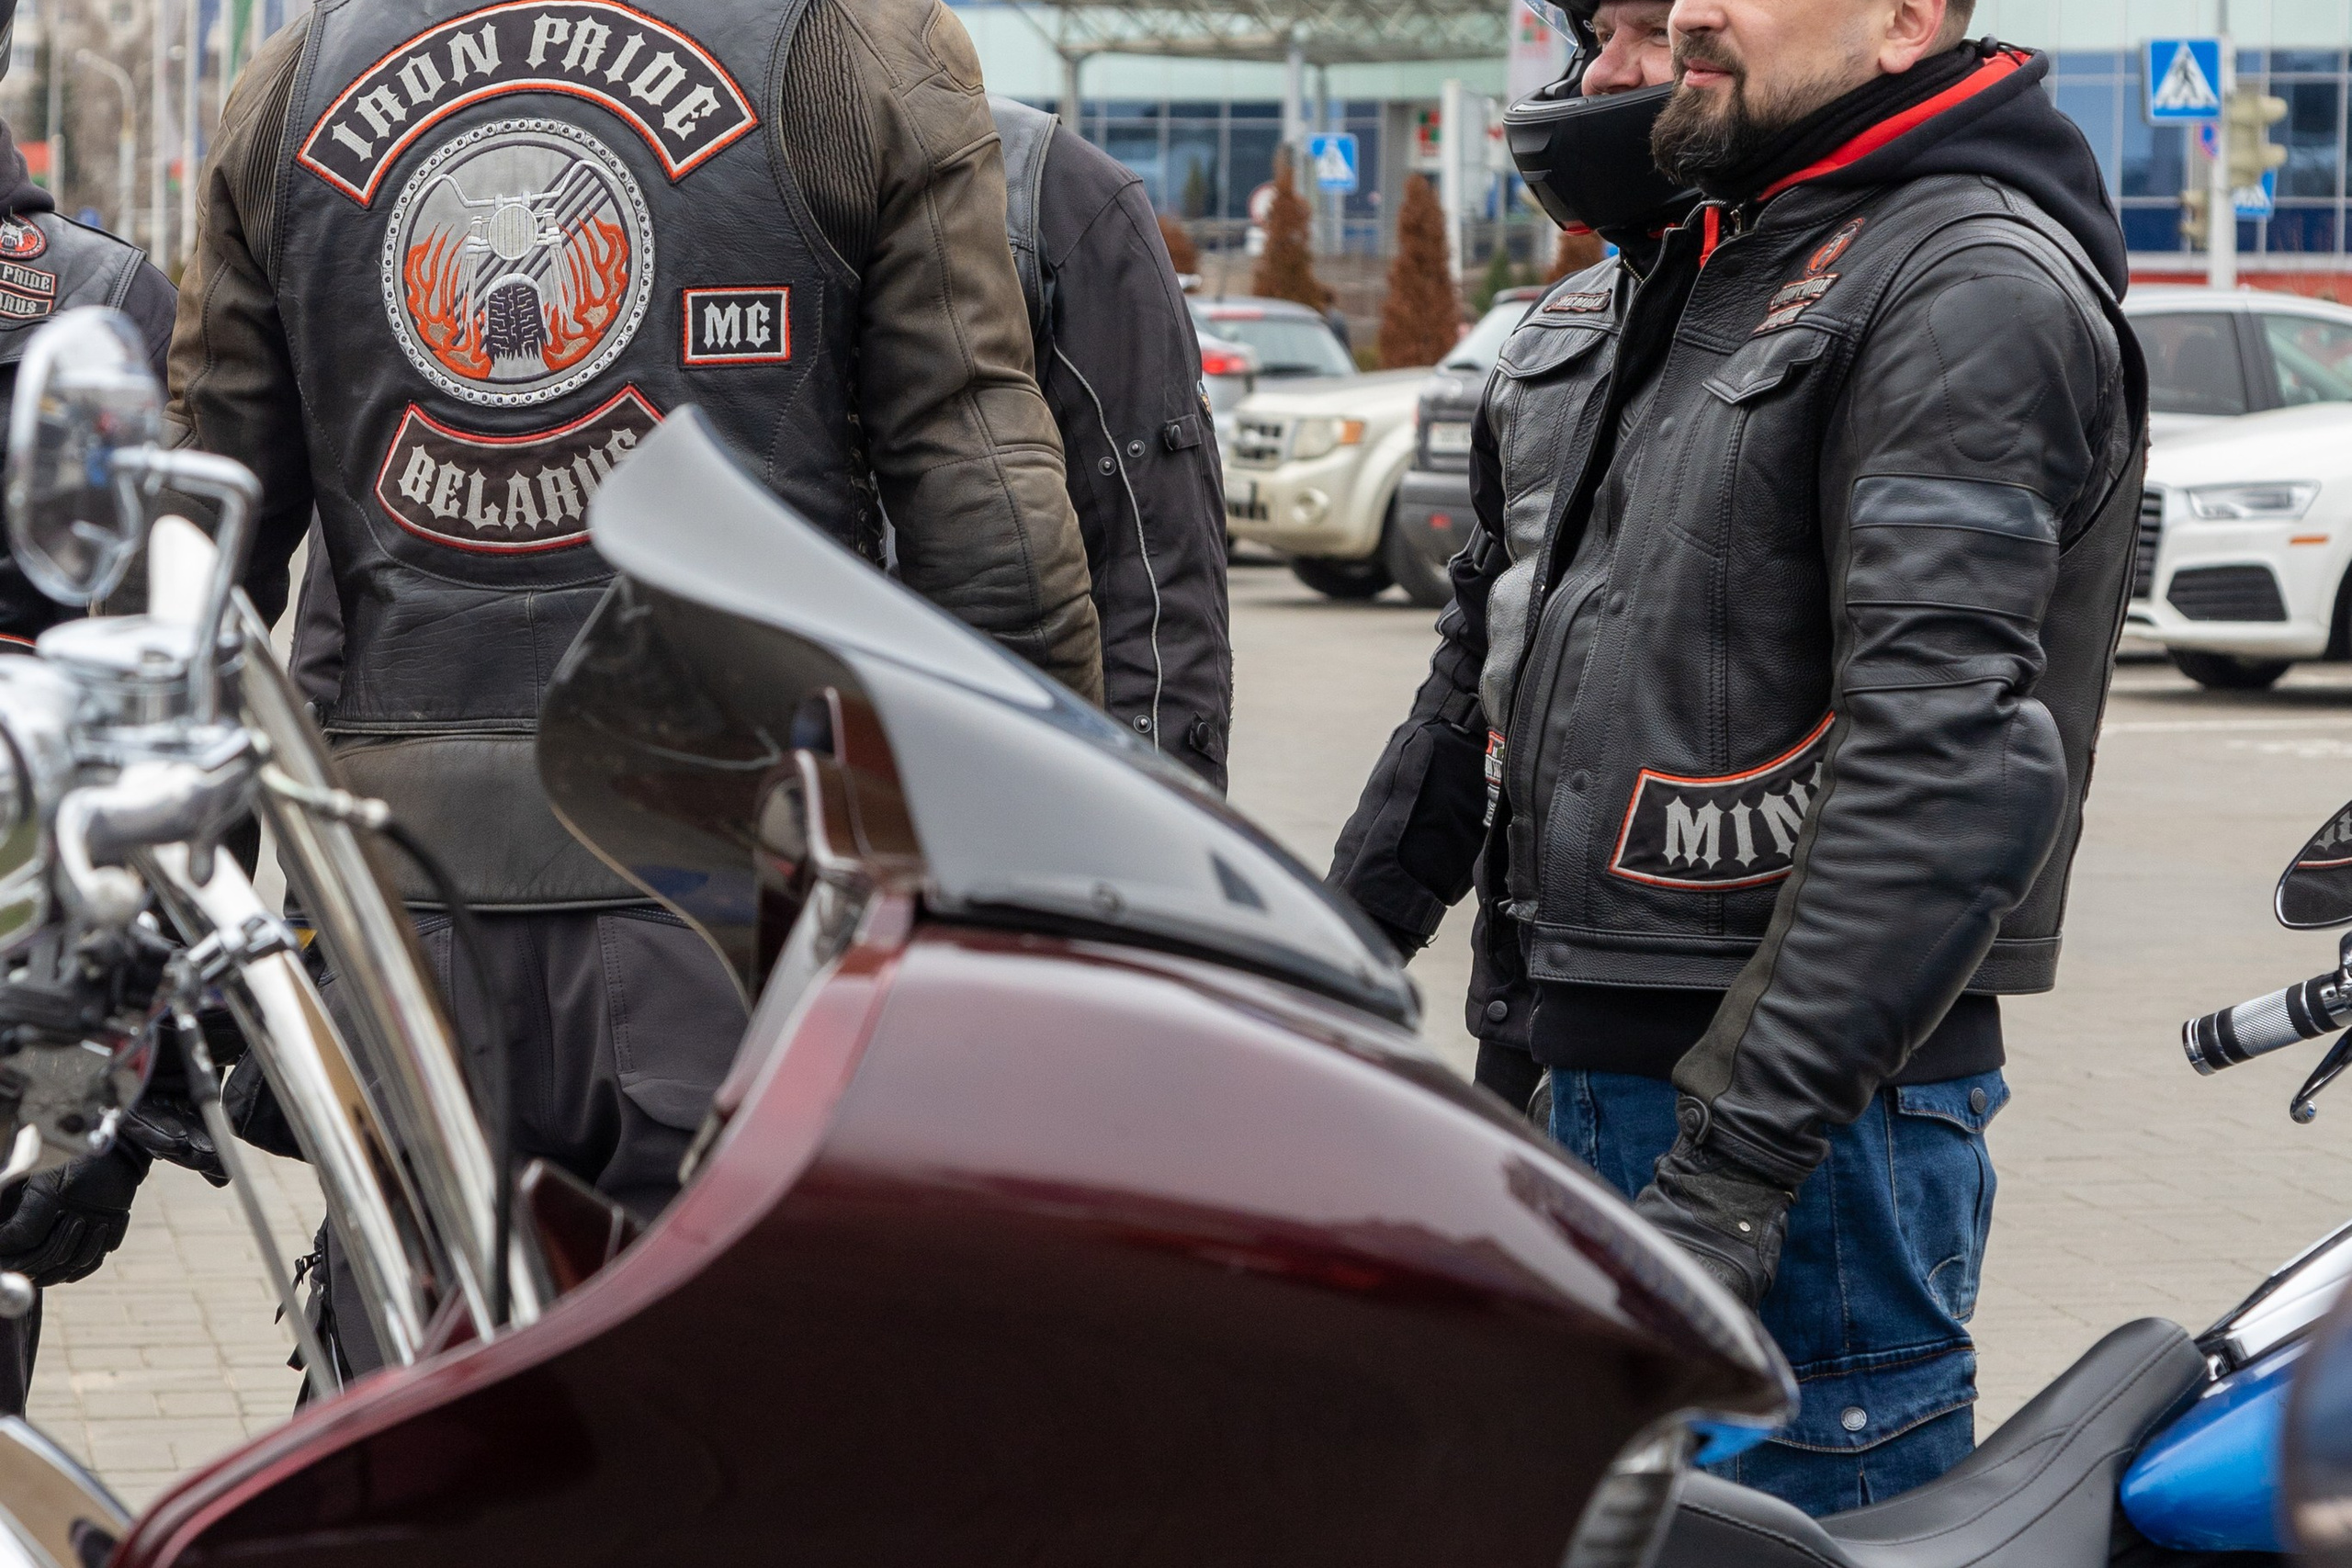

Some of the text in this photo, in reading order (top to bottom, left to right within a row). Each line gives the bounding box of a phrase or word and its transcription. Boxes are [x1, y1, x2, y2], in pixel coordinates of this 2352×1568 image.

[332, 12, 721, 162] IRON PRIDE
[2, 265, 51, 291] PRIDE
[703, 299, 771, 349] MC
[1662, 761, 1824, 870] MIN
